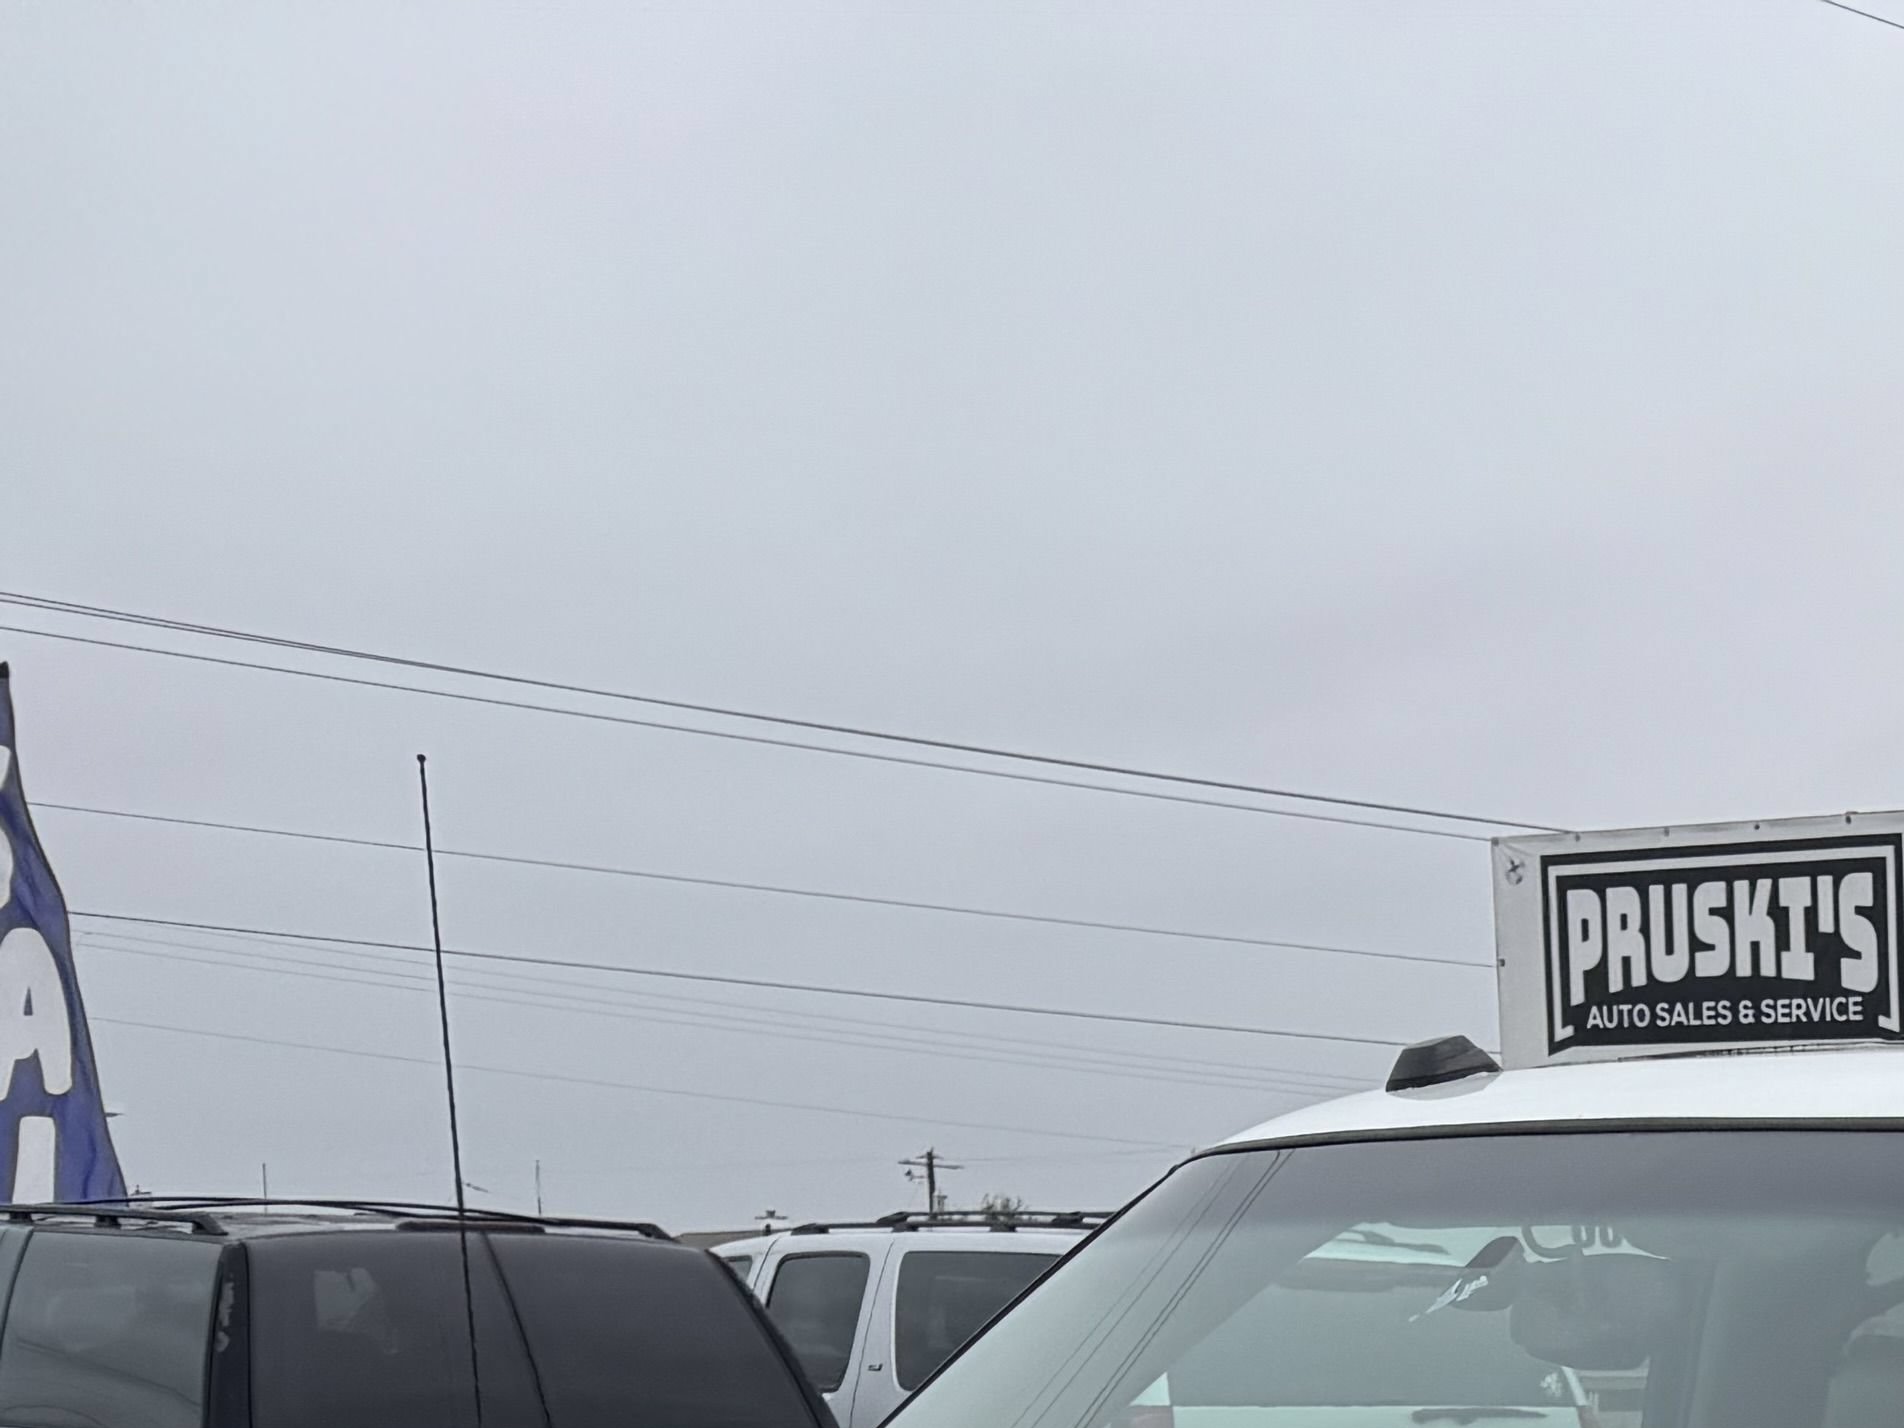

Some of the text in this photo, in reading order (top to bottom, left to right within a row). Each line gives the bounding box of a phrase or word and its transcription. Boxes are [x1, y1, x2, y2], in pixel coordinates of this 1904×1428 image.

[1566, 872, 1879, 1006] PRUSKI'S
[1585, 996, 1864, 1029] AUTO SALES & SERVICE
